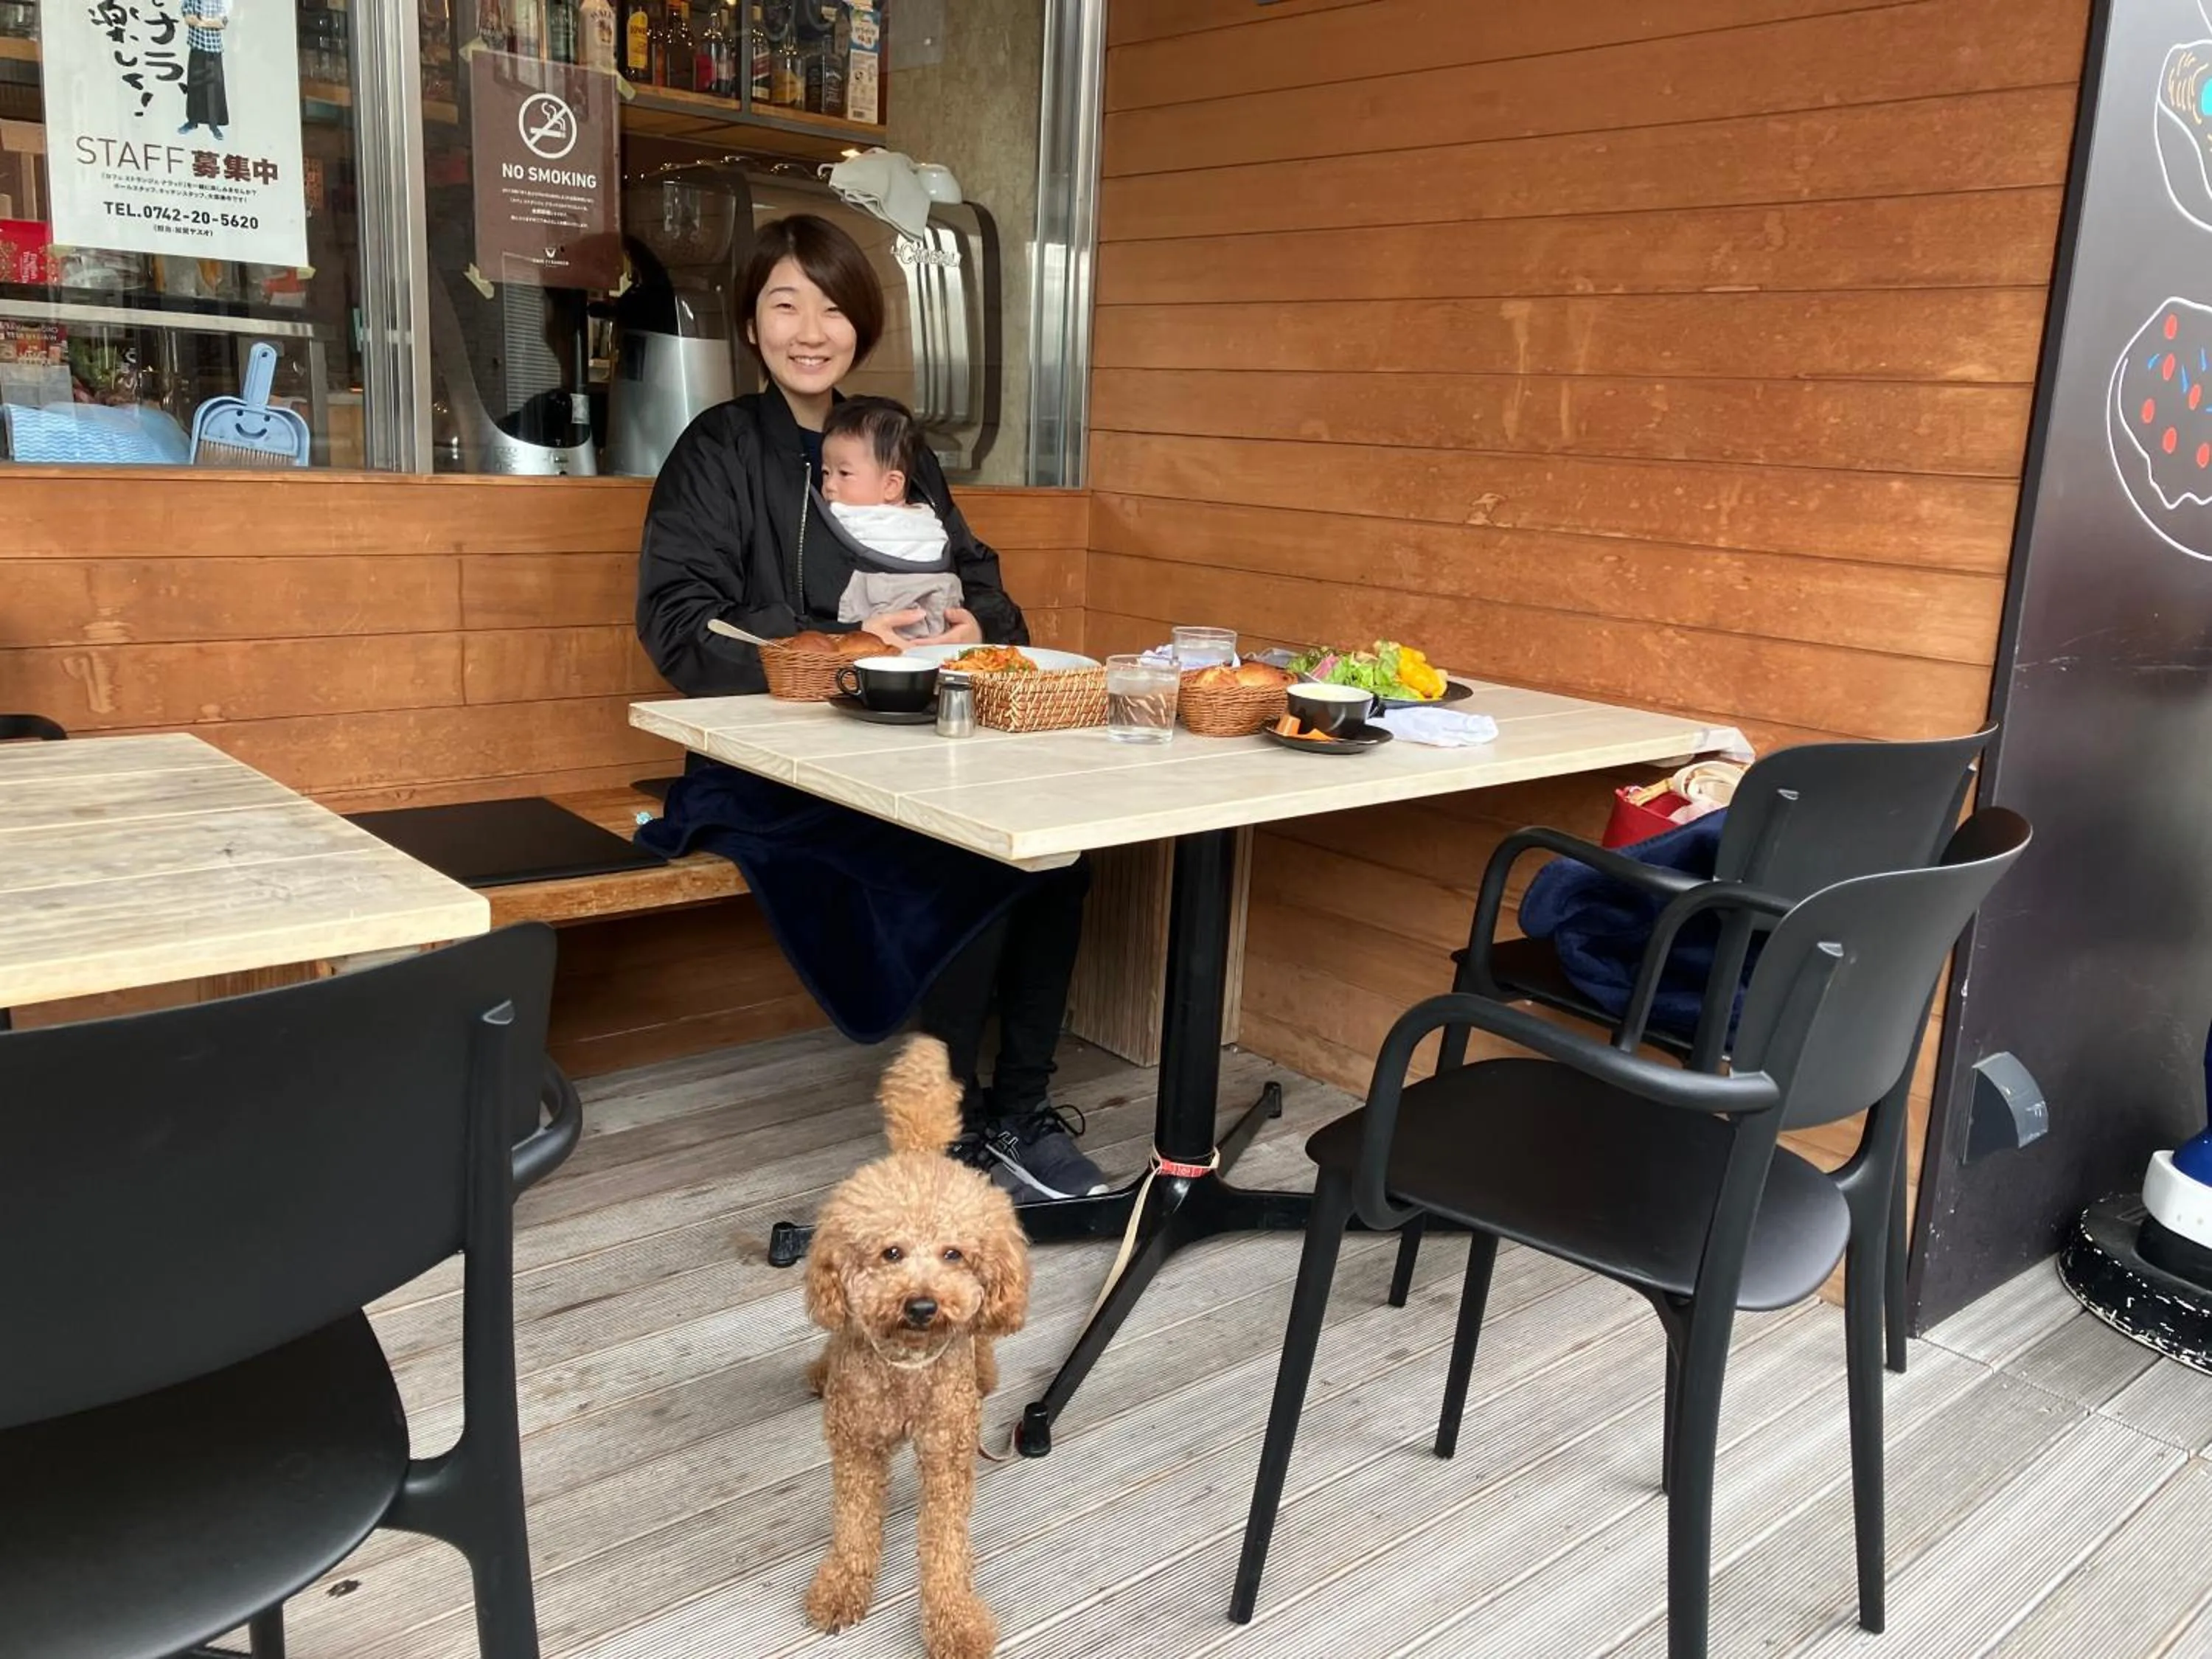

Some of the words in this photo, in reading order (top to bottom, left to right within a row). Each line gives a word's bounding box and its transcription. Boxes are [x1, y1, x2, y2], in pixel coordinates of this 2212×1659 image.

[145, 0, 188, 94] ナラ、
[76, 136, 184, 174] STAFF
[191, 150, 279, 185] 募集中
[502, 163, 524, 179] NO
[528, 167, 597, 188] SMOKING
